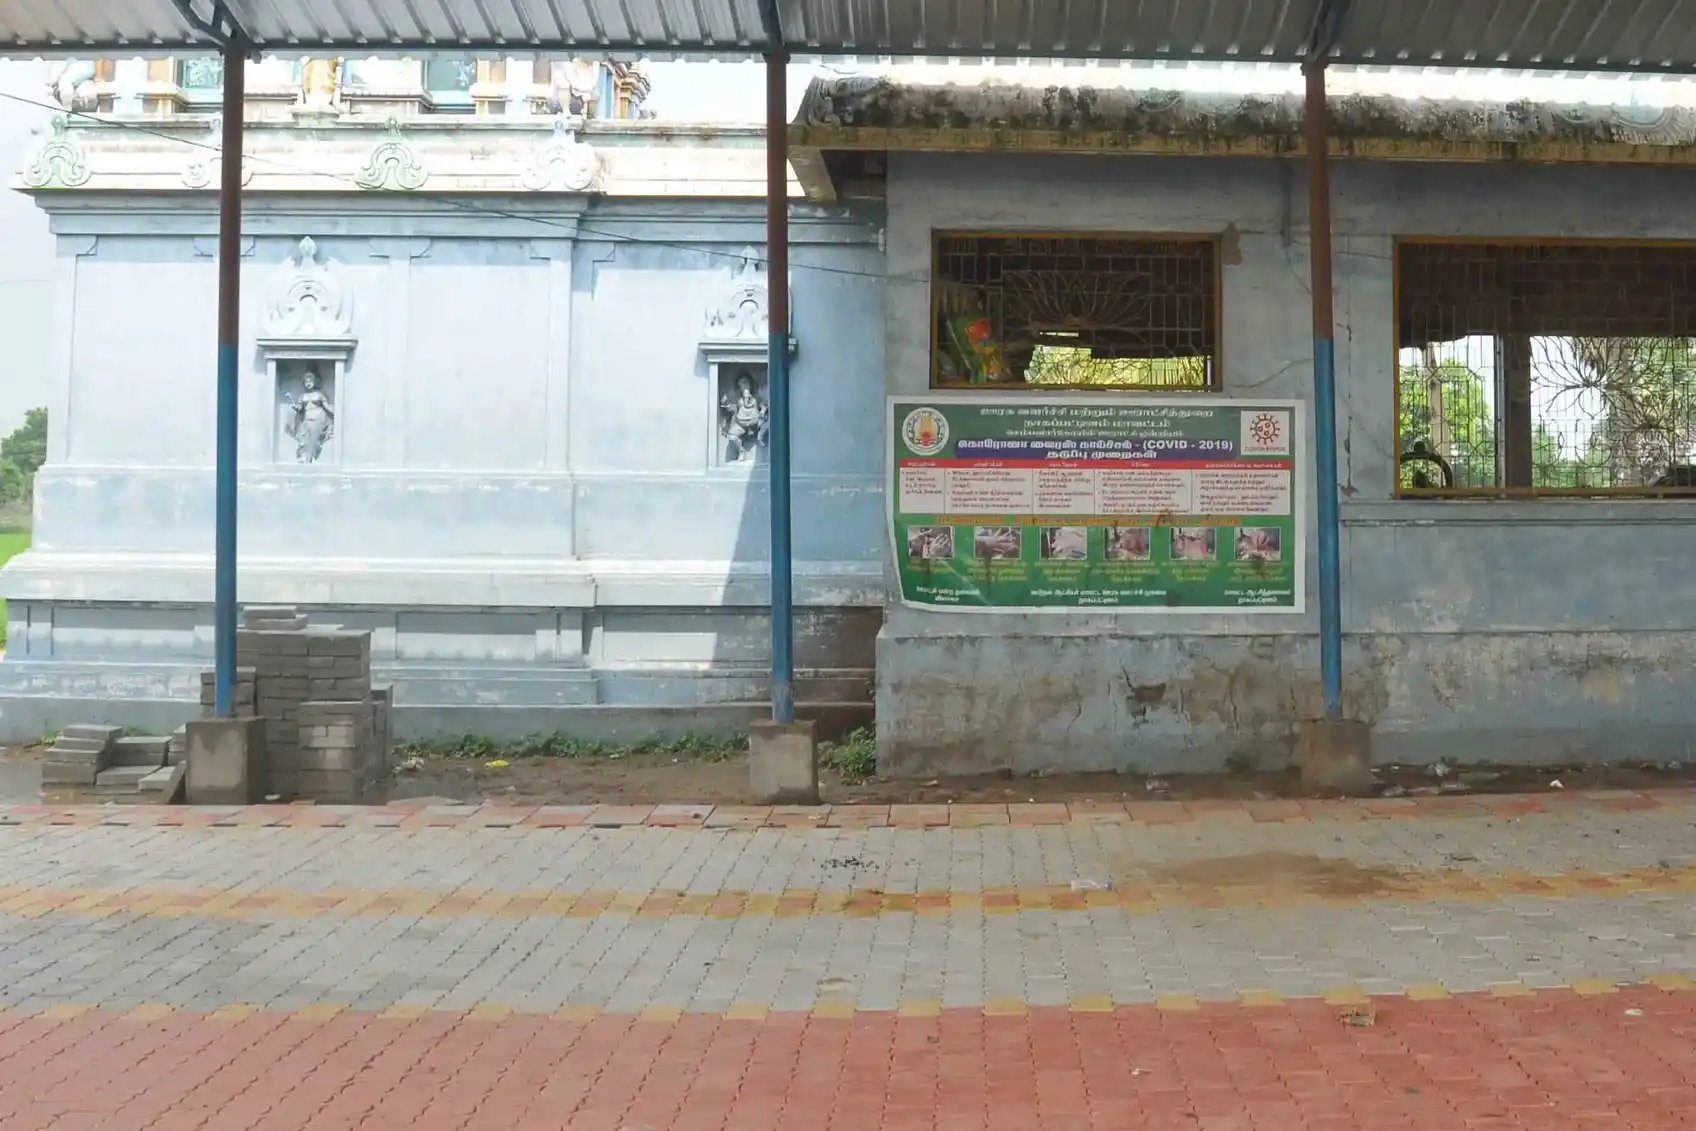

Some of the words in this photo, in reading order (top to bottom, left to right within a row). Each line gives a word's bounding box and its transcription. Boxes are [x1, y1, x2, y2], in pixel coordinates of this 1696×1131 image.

[958, 438, 1028, 450] கொரோனா
[1030, 439, 1077, 450] வைரஸ்
[1142, 439, 1188, 450] (COVID
[1091, 450, 1157, 460] முறைகள்
